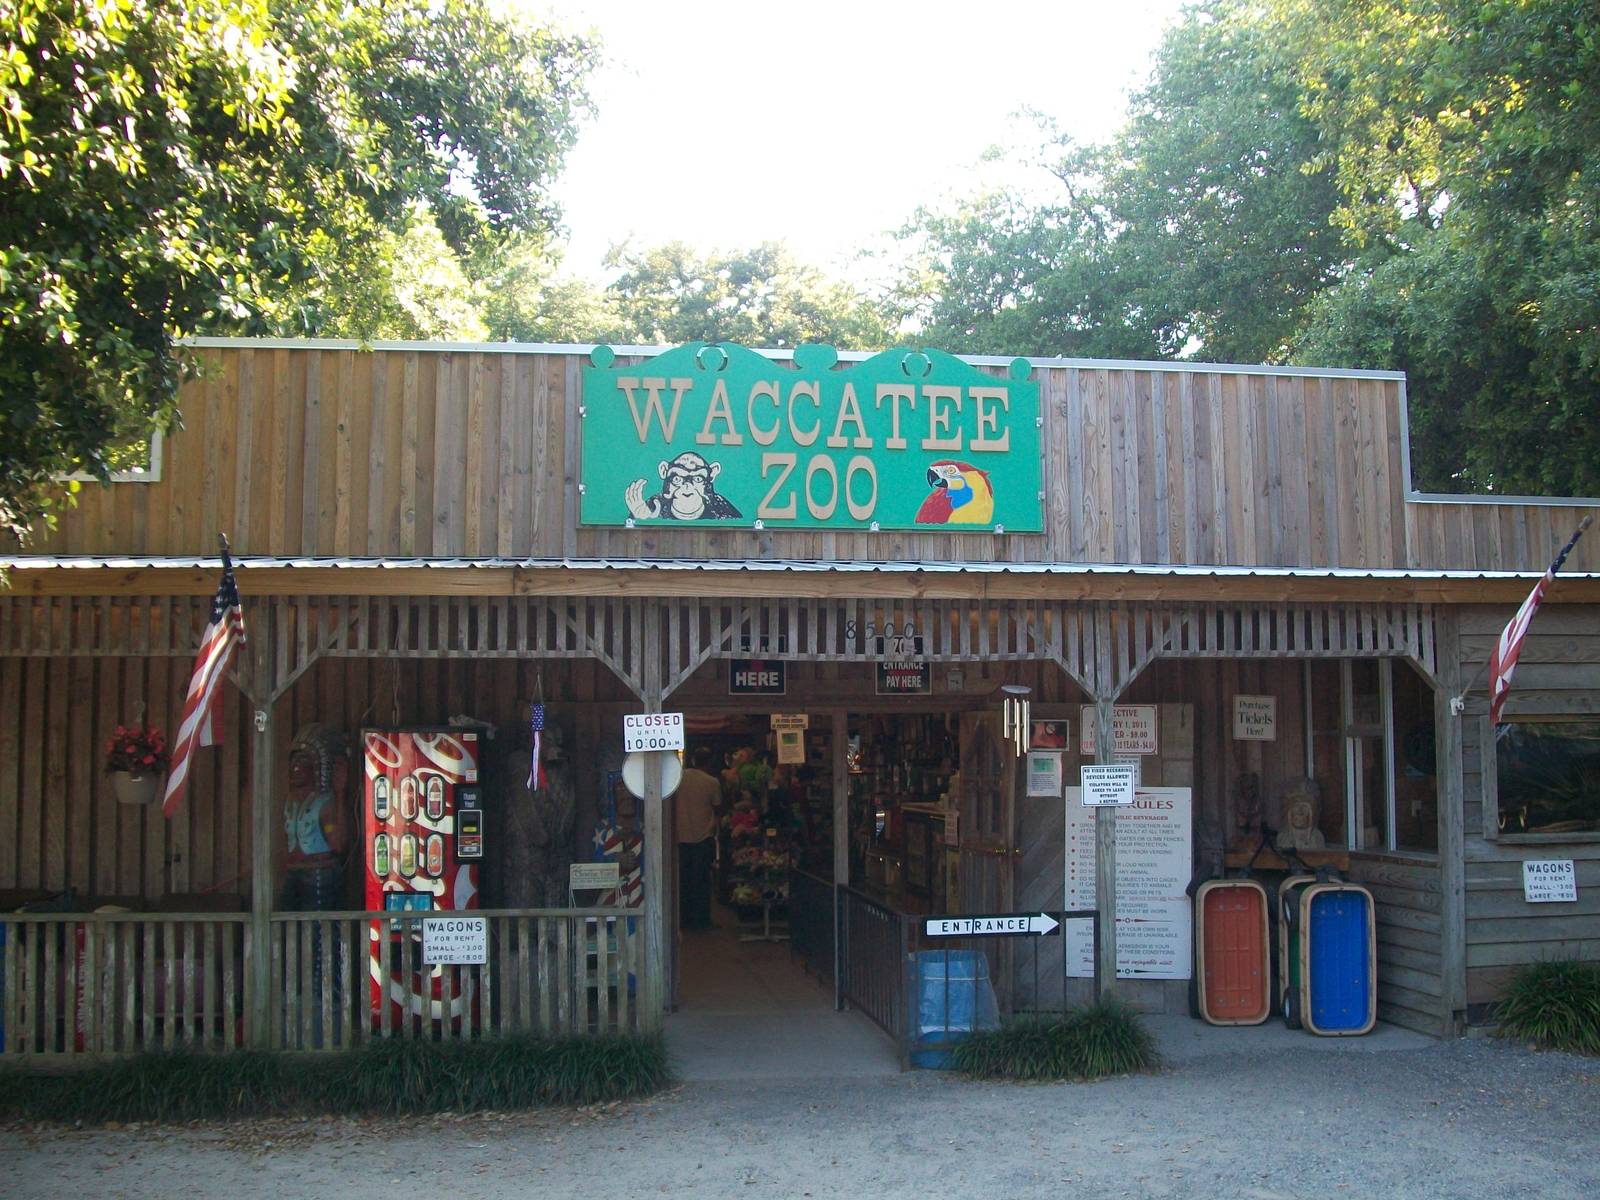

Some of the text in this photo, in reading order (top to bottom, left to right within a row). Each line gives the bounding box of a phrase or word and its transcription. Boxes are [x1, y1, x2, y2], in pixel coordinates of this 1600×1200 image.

[616, 376, 1010, 452] WACCATEE
[757, 452, 877, 521] ZOO
[846, 620, 914, 639] 8500
[883, 661, 924, 670] ENTRANCE
[735, 671, 779, 686] HERE
[886, 676, 922, 687] PAY HERE
[1113, 709, 1137, 717] ECTIVE
[1237, 711, 1272, 725] Tickets
[626, 715, 680, 727] CLOSED
[627, 738, 666, 750] 10:00
[1526, 863, 1571, 873] WAGONS
[427, 921, 483, 932] WAGONS
[941, 919, 1026, 932] ENTRANCE
